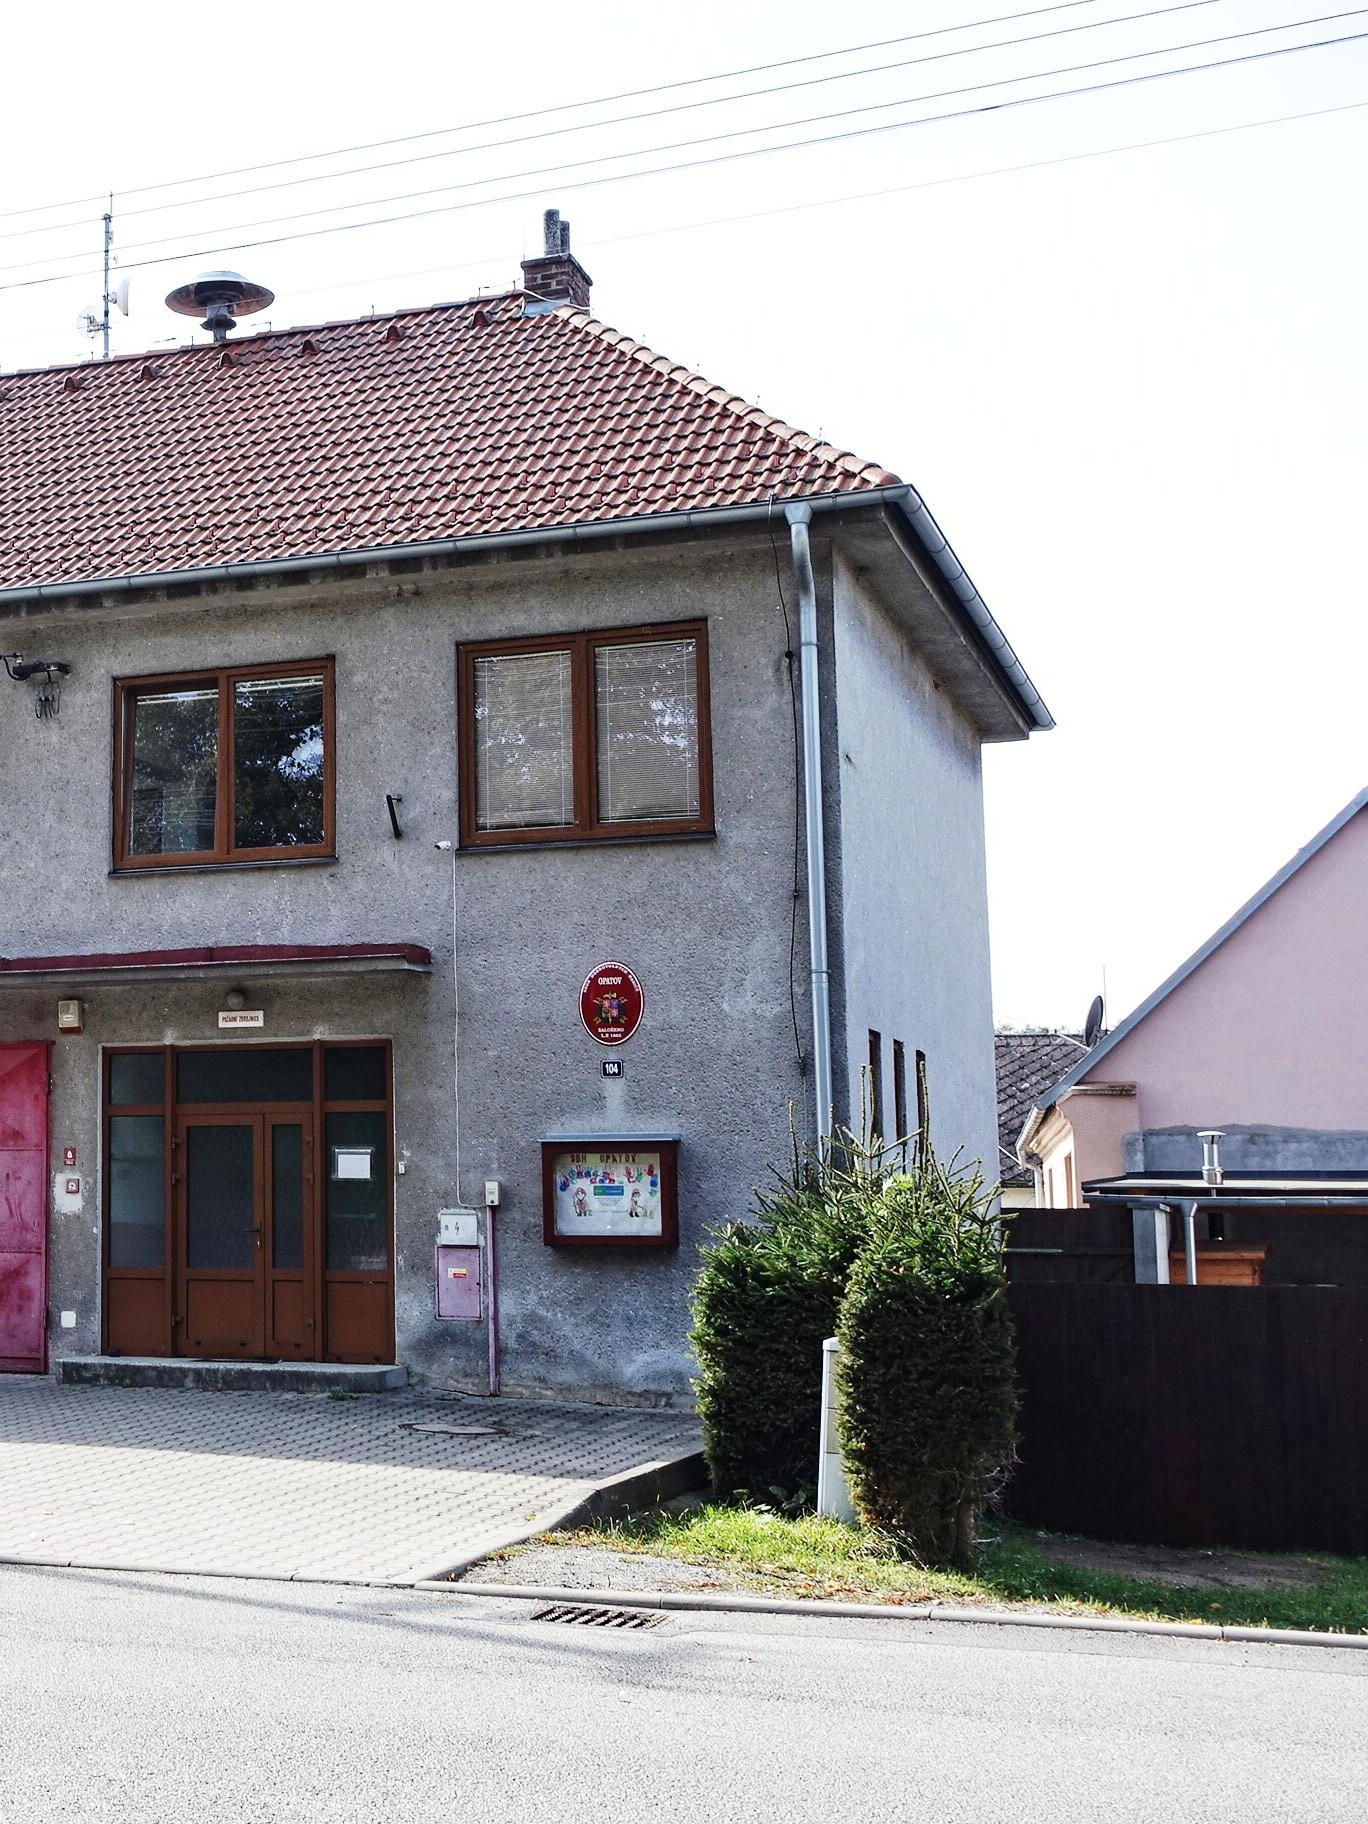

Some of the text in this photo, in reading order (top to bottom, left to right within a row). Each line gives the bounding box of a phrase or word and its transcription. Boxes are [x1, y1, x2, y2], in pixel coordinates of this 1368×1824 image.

[597, 976, 623, 986] OPATOV
[605, 1063, 619, 1074] 104
[570, 1154, 637, 1163] SDH OPATOV
